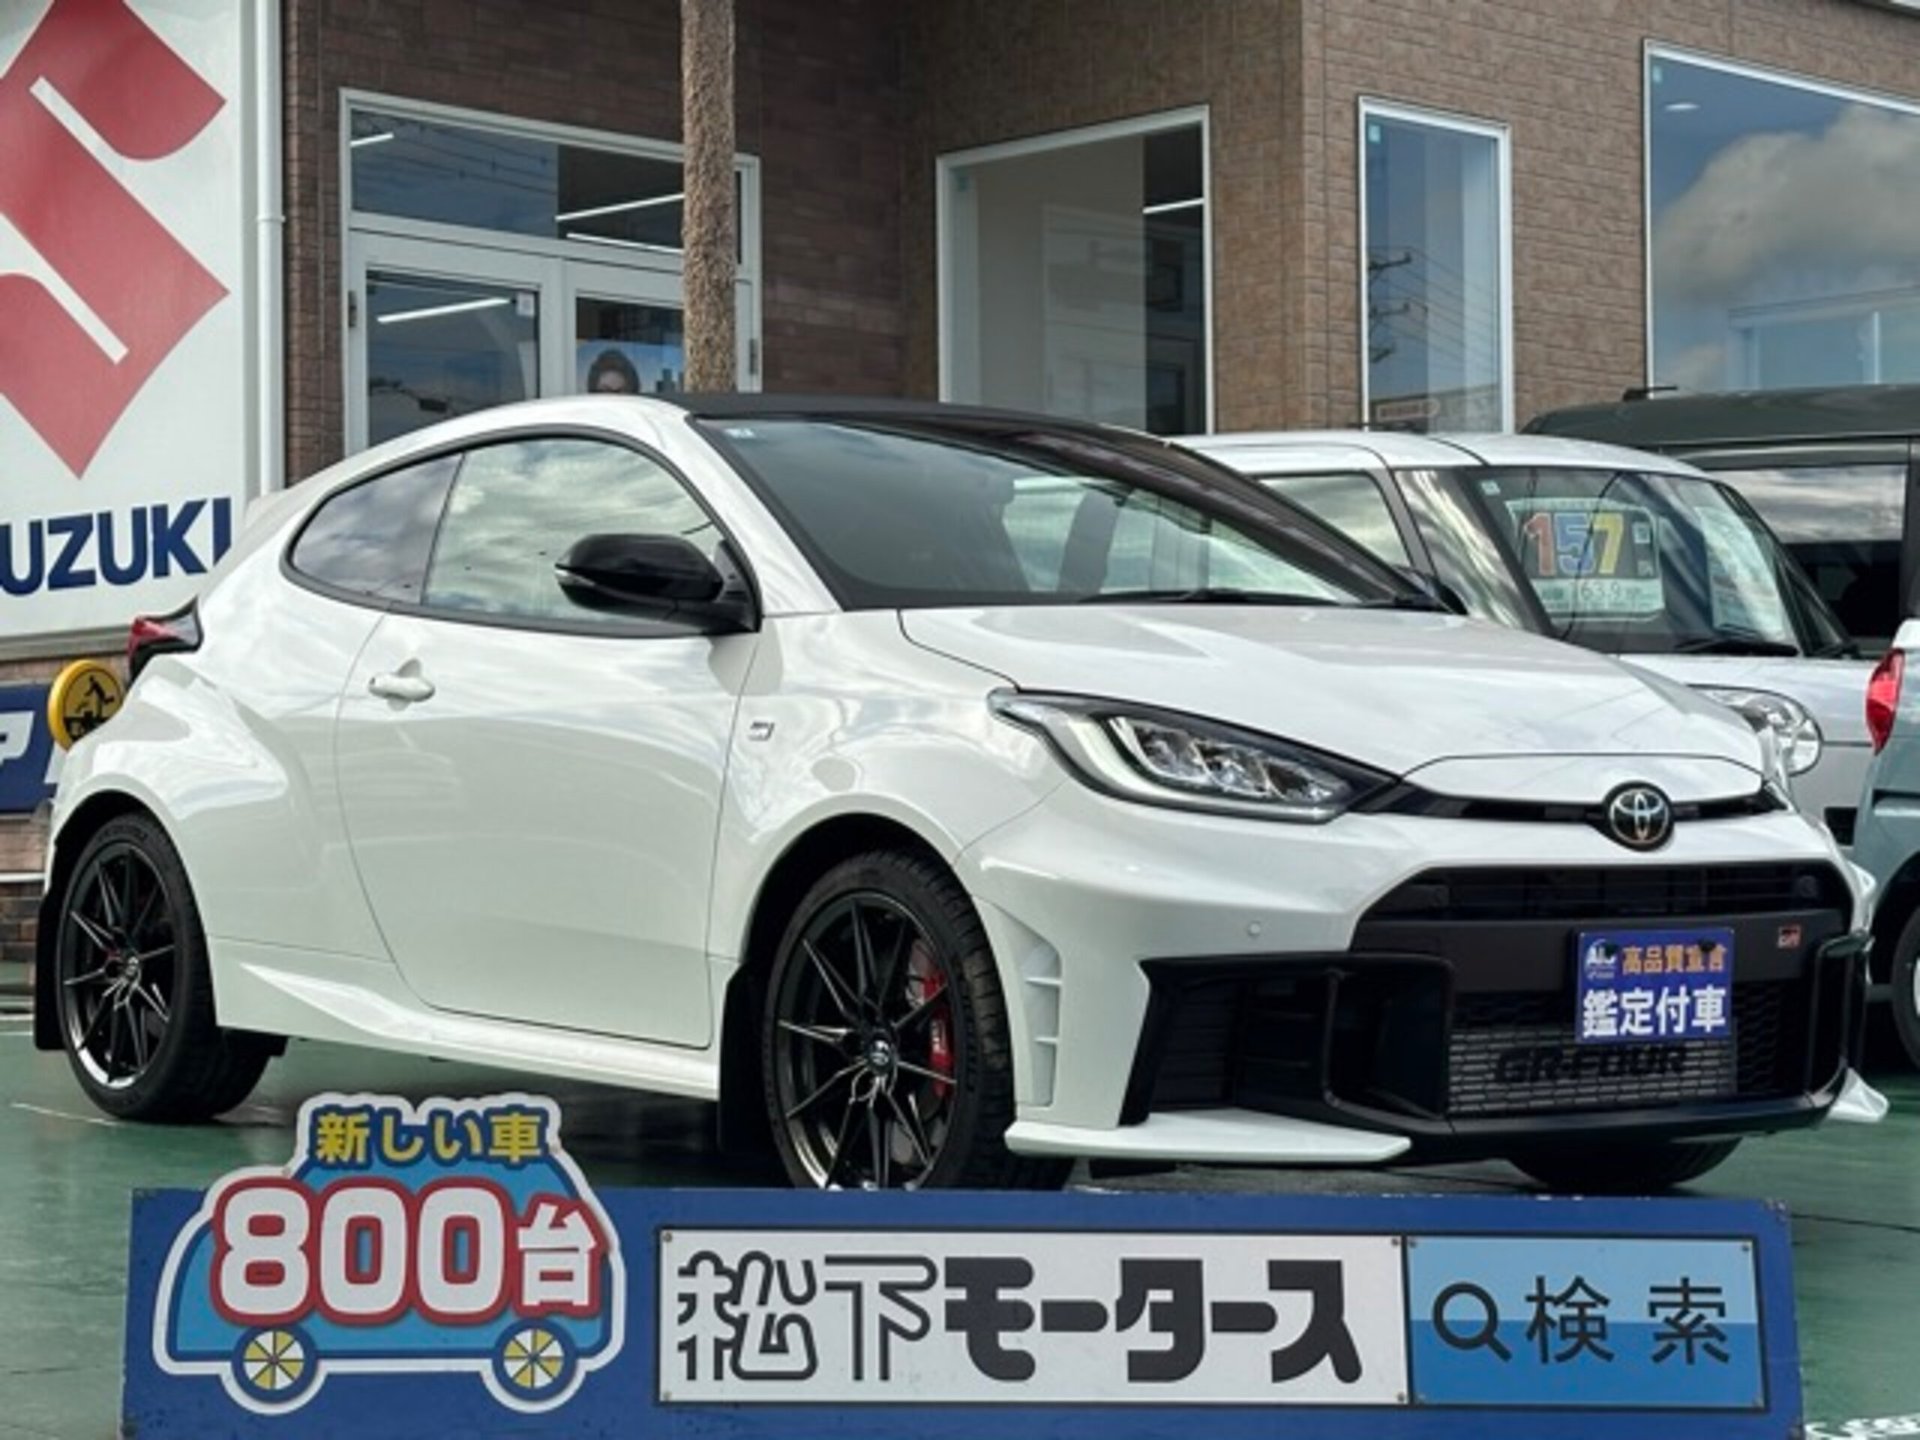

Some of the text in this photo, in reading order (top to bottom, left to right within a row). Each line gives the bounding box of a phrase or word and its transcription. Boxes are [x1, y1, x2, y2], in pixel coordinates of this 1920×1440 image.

[1524, 511, 1624, 576] 157
[1583, 984, 1726, 1038] 鑑定付車
[315, 1110, 546, 1164] 新しい車
[218, 1187, 597, 1316] 800台
[677, 1250, 1363, 1384] 松下モータース
[1526, 1276, 1730, 1365] 検索
